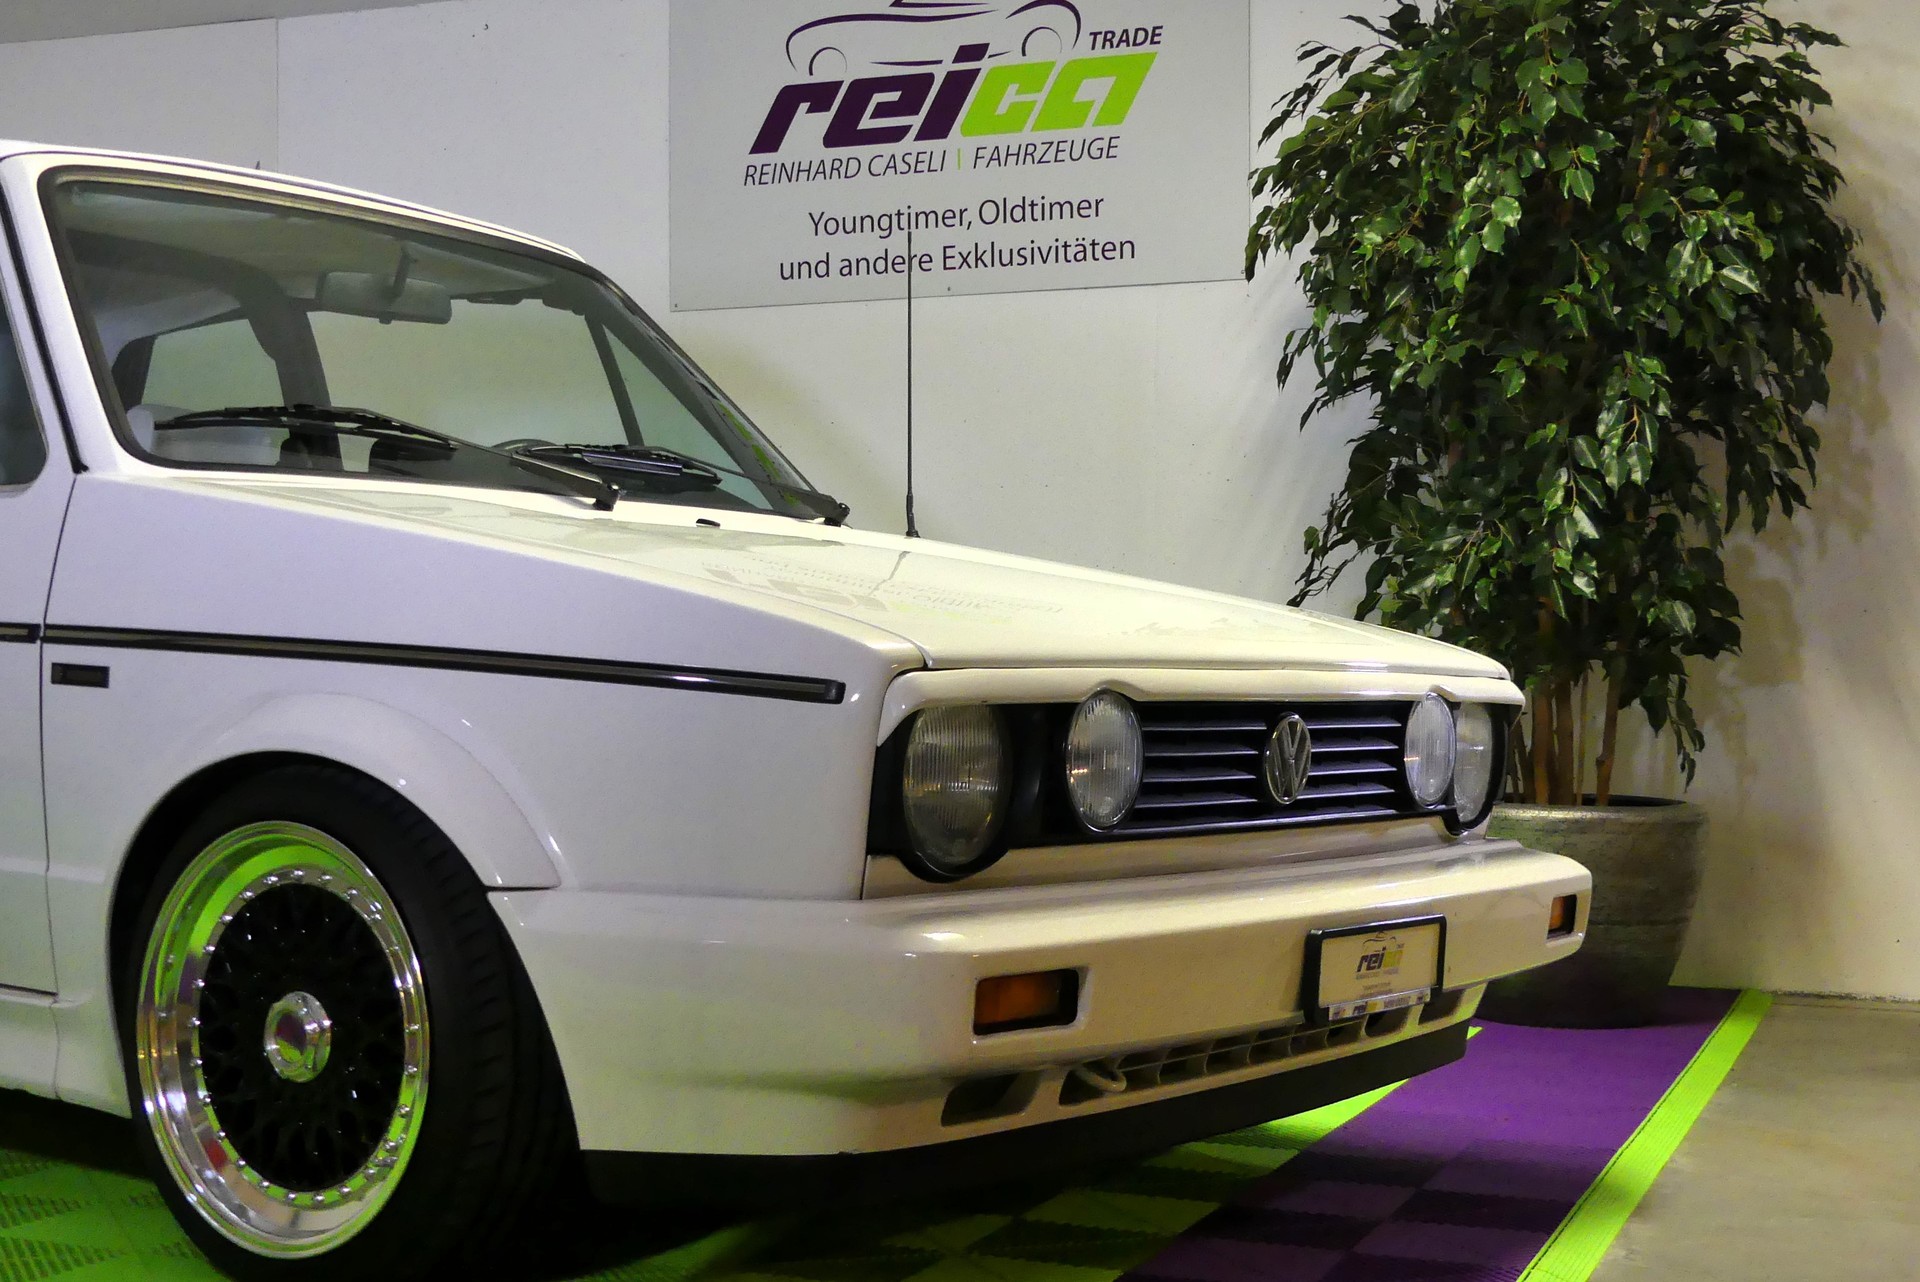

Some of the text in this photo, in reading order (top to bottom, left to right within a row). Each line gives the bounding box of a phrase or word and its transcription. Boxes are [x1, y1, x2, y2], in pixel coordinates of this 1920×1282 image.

[1089, 26, 1163, 51] TRADE
[749, 43, 1158, 155] reica
[743, 136, 1120, 187] REINHARD CASELI FAHRZEUGE
[808, 195, 1104, 239] Youngtimer, Oldtimer
[779, 236, 1136, 281] und andere Exklusivitäten
